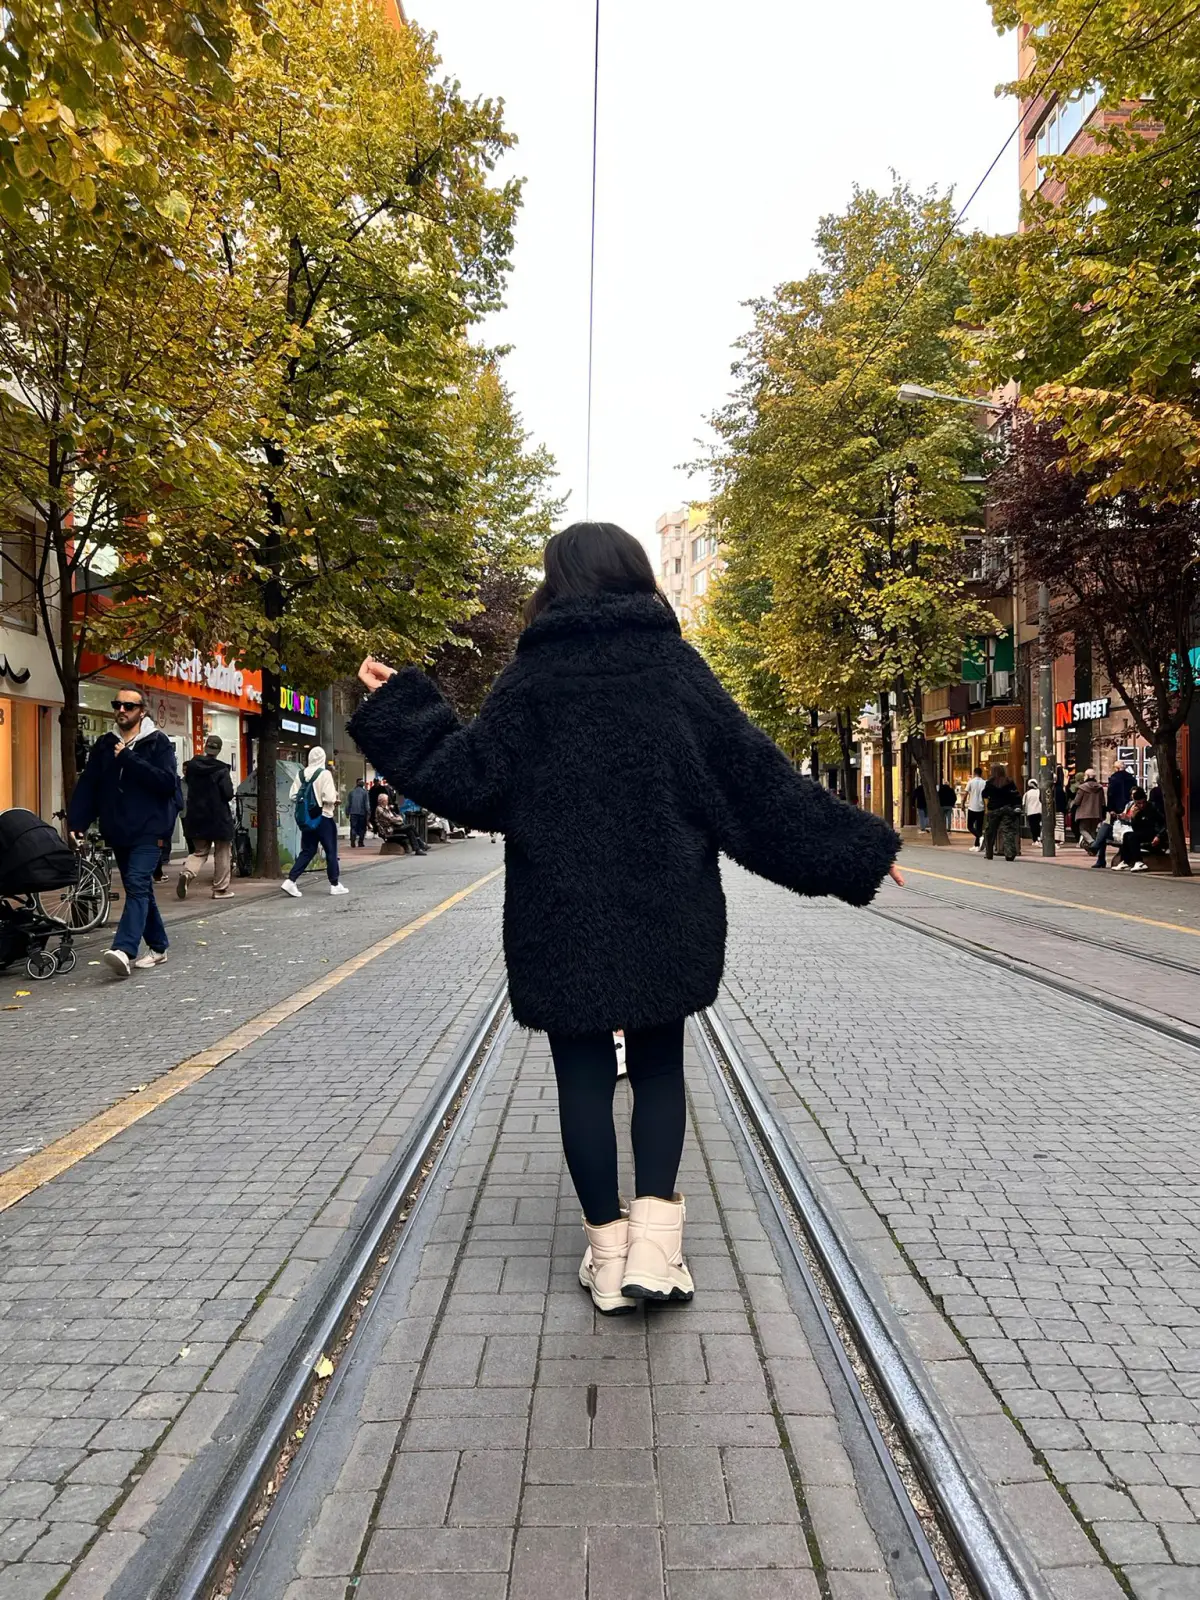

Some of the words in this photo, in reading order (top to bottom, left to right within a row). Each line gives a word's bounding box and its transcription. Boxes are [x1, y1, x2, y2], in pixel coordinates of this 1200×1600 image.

[280, 685, 318, 718] DÜNYASI
[1056, 700, 1073, 728] IN
[1073, 698, 1108, 721] STREET
